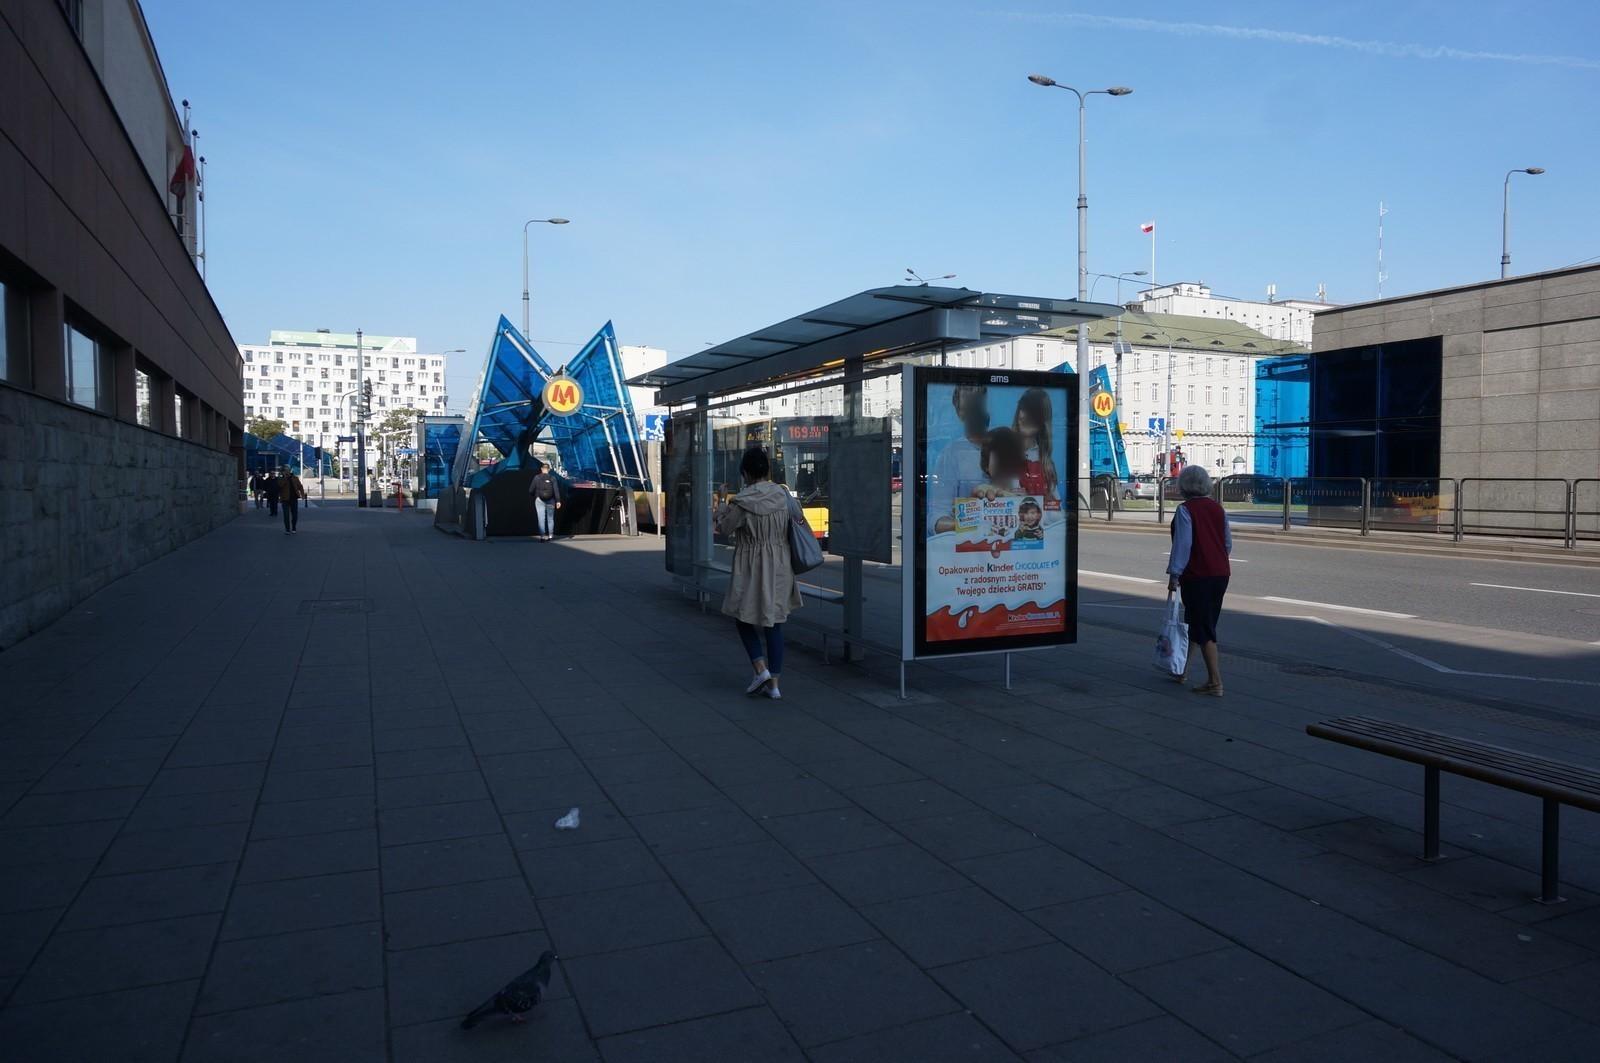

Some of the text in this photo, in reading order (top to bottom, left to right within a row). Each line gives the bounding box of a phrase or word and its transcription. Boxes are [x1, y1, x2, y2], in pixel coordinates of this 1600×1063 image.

[990, 374, 1009, 384] ams
[788, 425, 809, 440] 169
[939, 564, 984, 576] Opakowanie
[1015, 561, 1050, 571] CHOCOLATE
[971, 575, 1007, 585] radosnym
[1008, 573, 1039, 583] zdjęciem
[957, 586, 986, 597] Twojego
[988, 584, 1016, 593] dziecka
